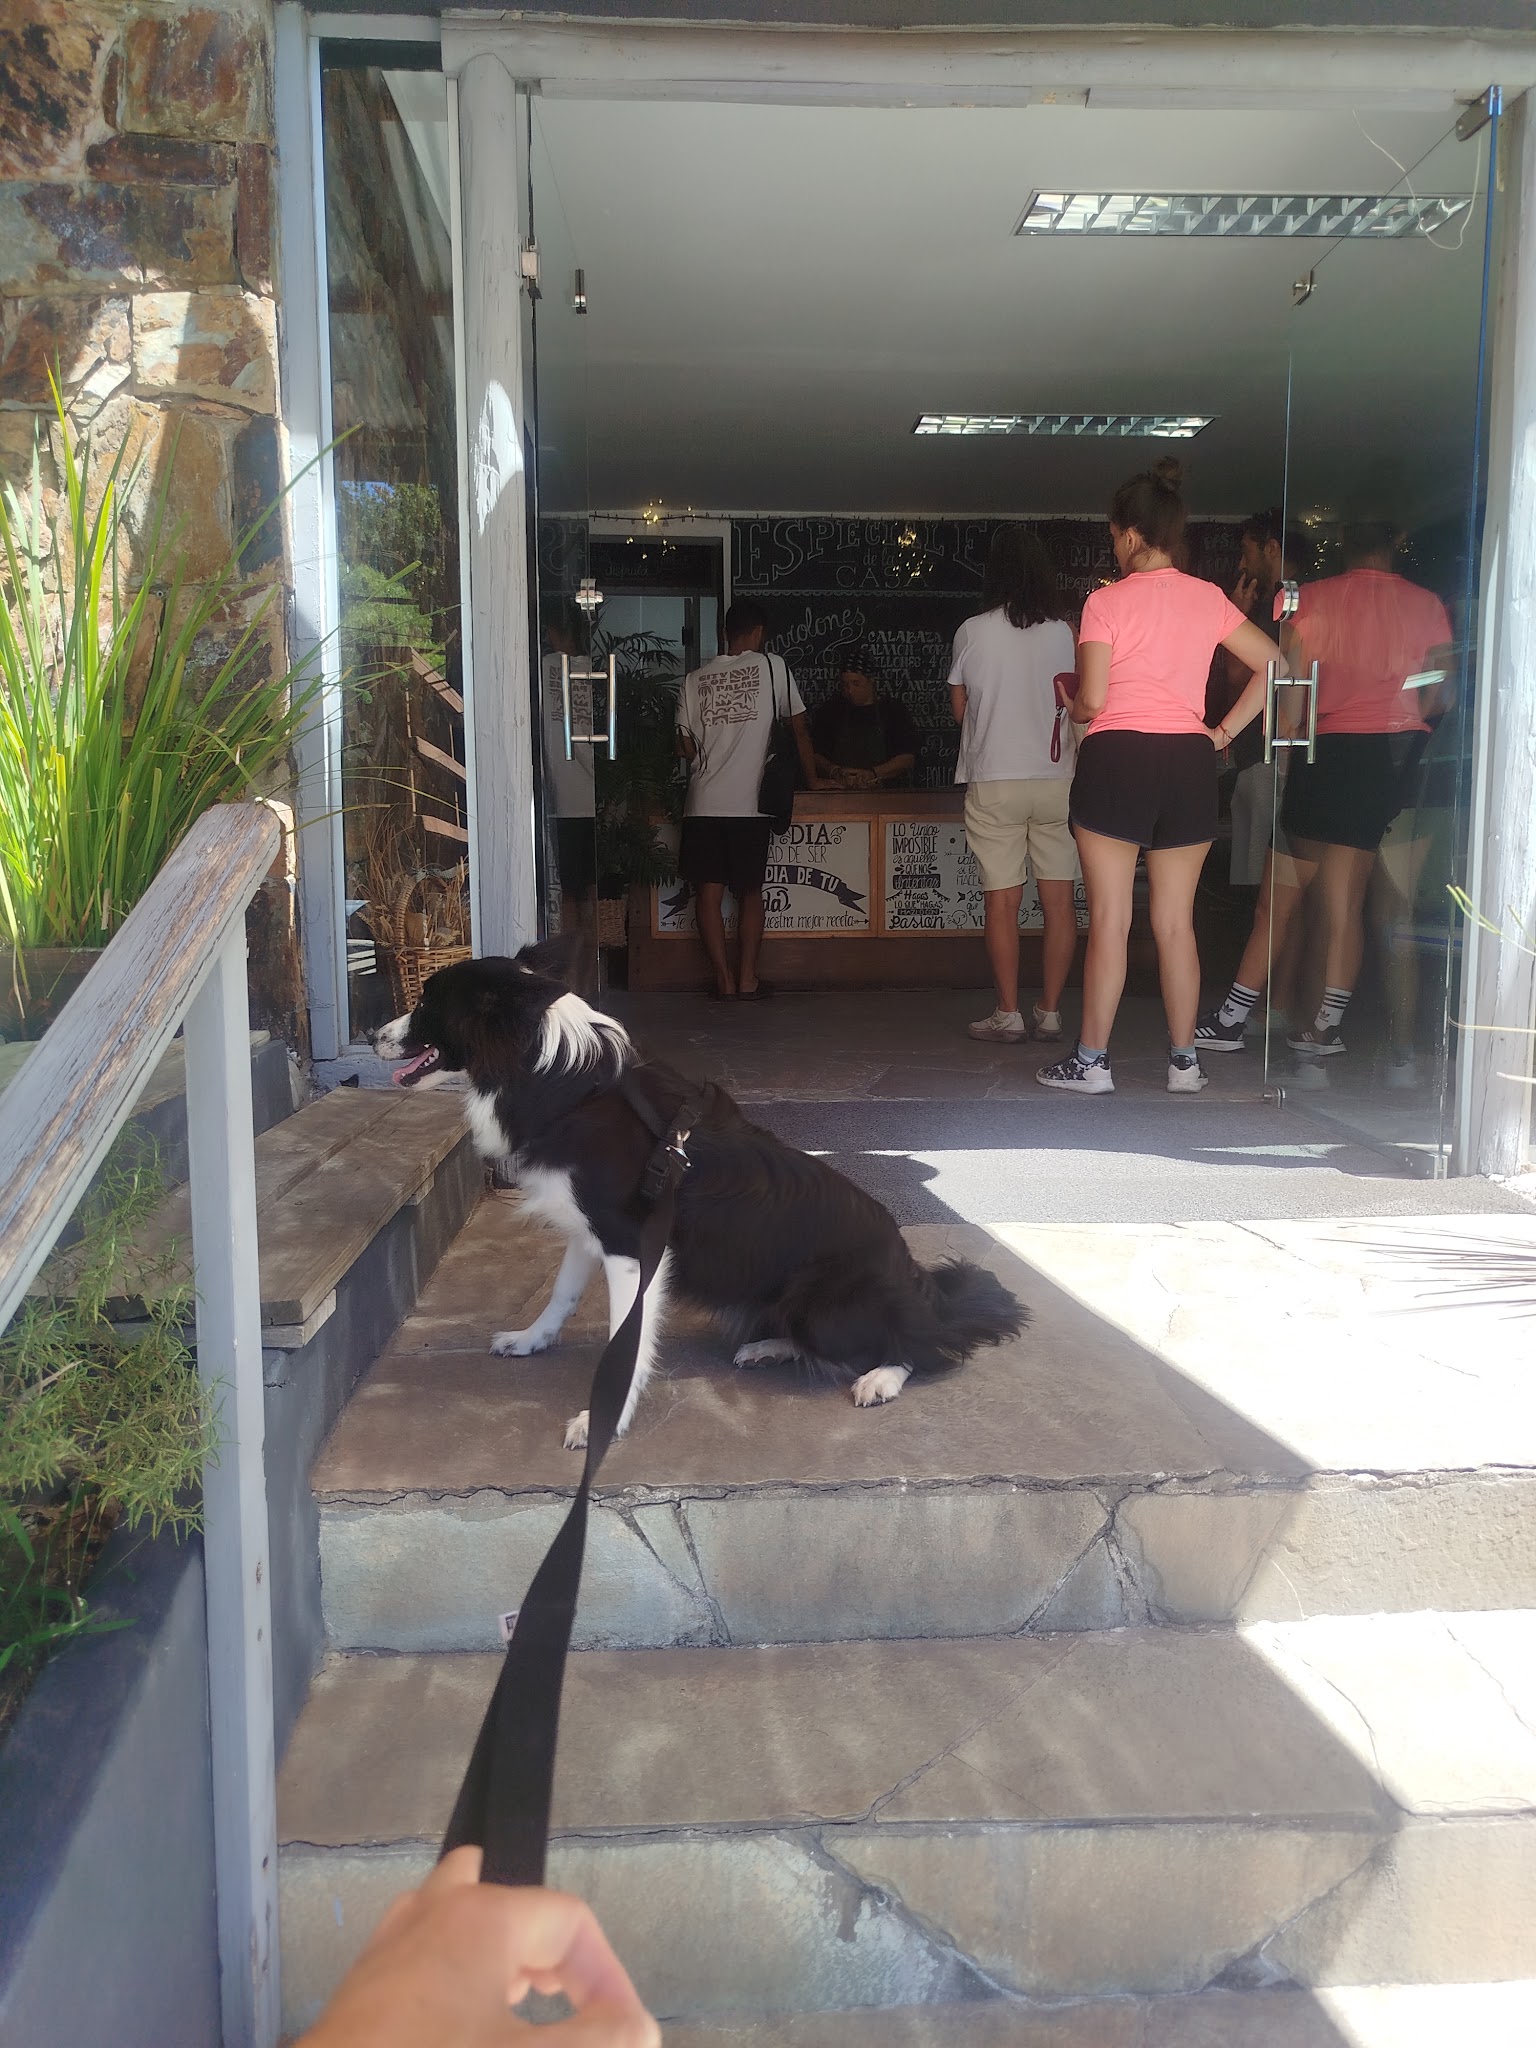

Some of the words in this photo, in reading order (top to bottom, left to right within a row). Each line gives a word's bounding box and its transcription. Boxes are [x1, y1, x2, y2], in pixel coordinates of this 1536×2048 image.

[862, 549, 877, 566] de
[835, 566, 928, 589] CASA
[764, 606, 867, 656] aviolones
[867, 630, 944, 644] CALABAZA
[698, 672, 729, 682] CITY
[710, 678, 728, 686] OF
[716, 680, 760, 692] PALMS
[790, 824, 832, 845] DIA
[893, 823, 906, 837] LO
[892, 836, 938, 855] IMPOSIBLE
[788, 845, 802, 864] DE
[807, 845, 828, 864] SER
[892, 854, 902, 864] es
[918, 863, 928, 874] NO
[764, 865, 789, 884] DIA
[796, 867, 812, 886] DE
[820, 875, 839, 893] TU
[895, 901, 903, 909] LO
[904, 901, 917, 909] QUE
[920, 901, 944, 909] HAGAS
[797, 916, 825, 931] mejor
[825, 911, 855, 928] receta
